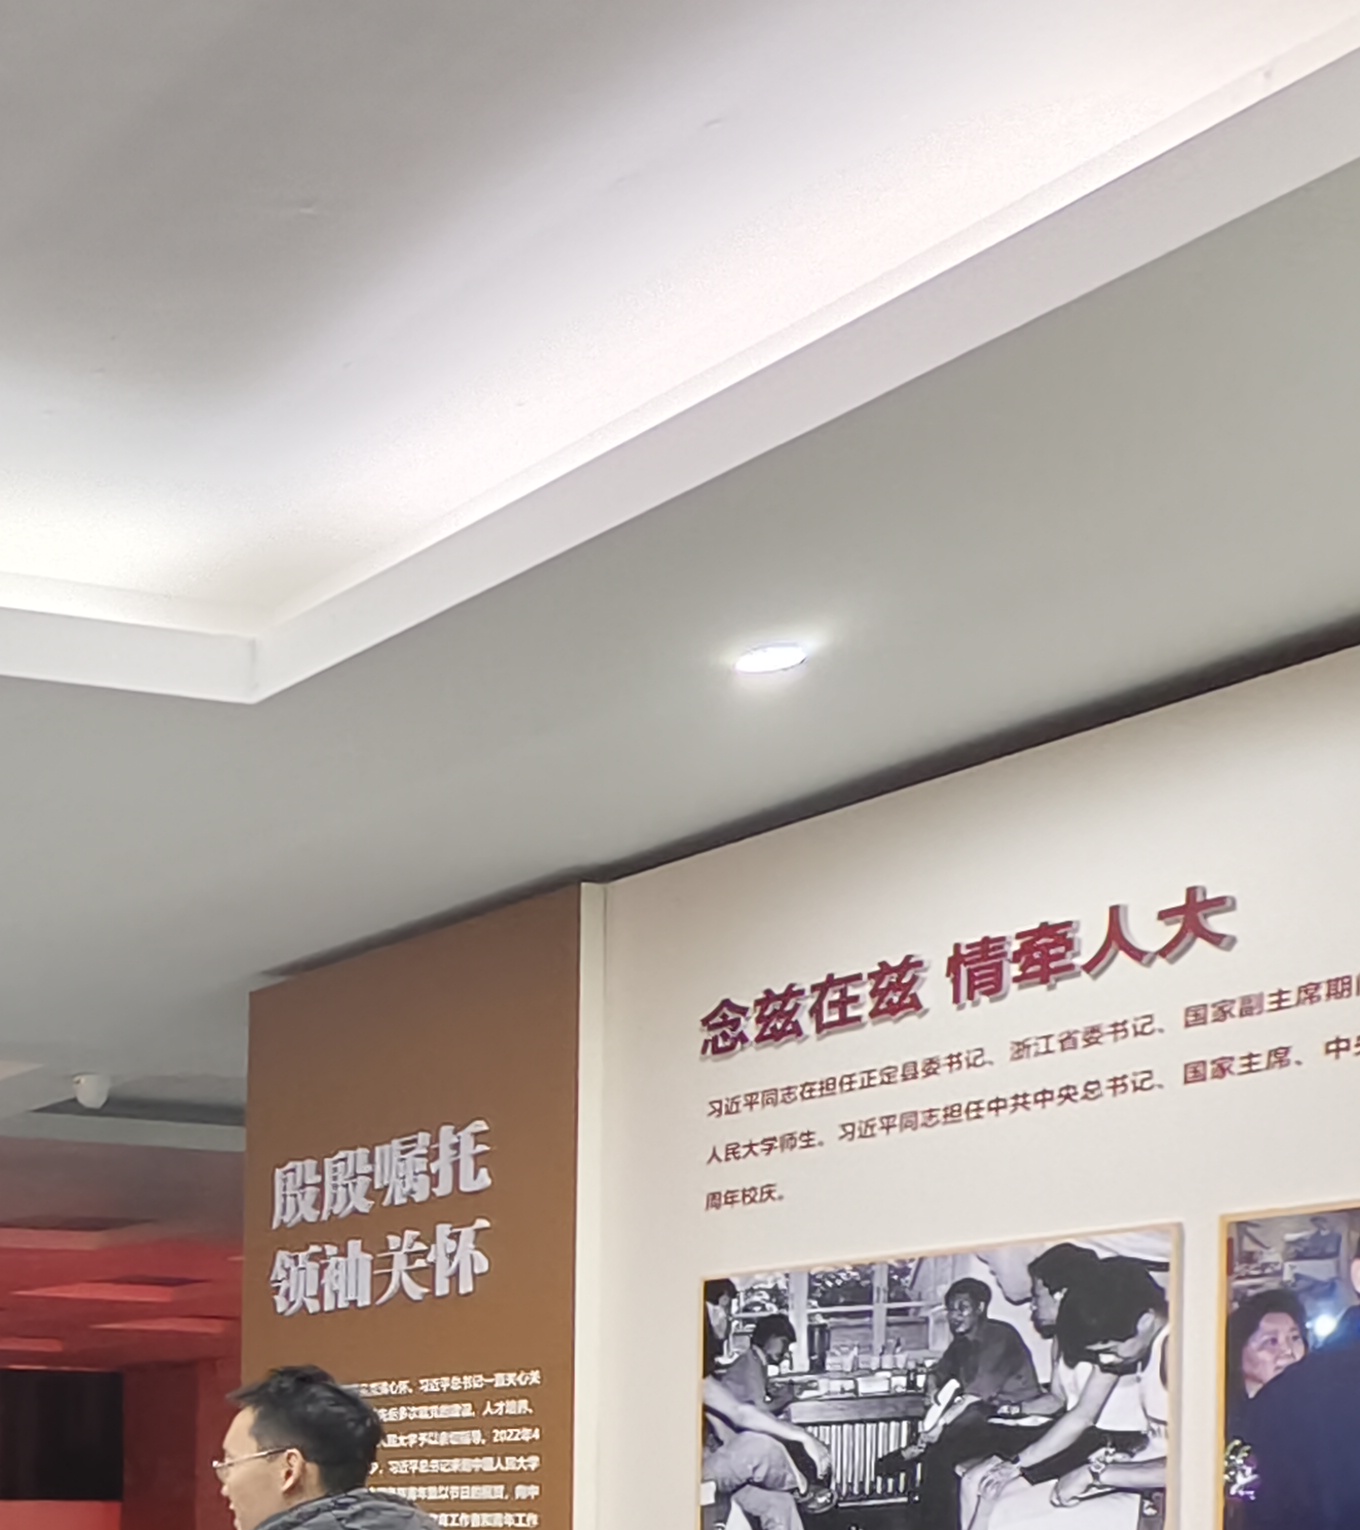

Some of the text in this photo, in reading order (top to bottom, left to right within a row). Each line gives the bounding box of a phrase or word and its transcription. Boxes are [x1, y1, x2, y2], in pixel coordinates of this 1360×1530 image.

[699, 885, 1237, 1058] 念兹在兹 情牵人大
[707, 973, 1360, 1118] 习近平同志在担任正定县委书记、浙江省委书记、国家副主席期
[271, 1119, 492, 1230] 殷殷嘱托
[704, 1183, 785, 1211] 周年校庆。
[270, 1218, 492, 1316] 领袖关怀
